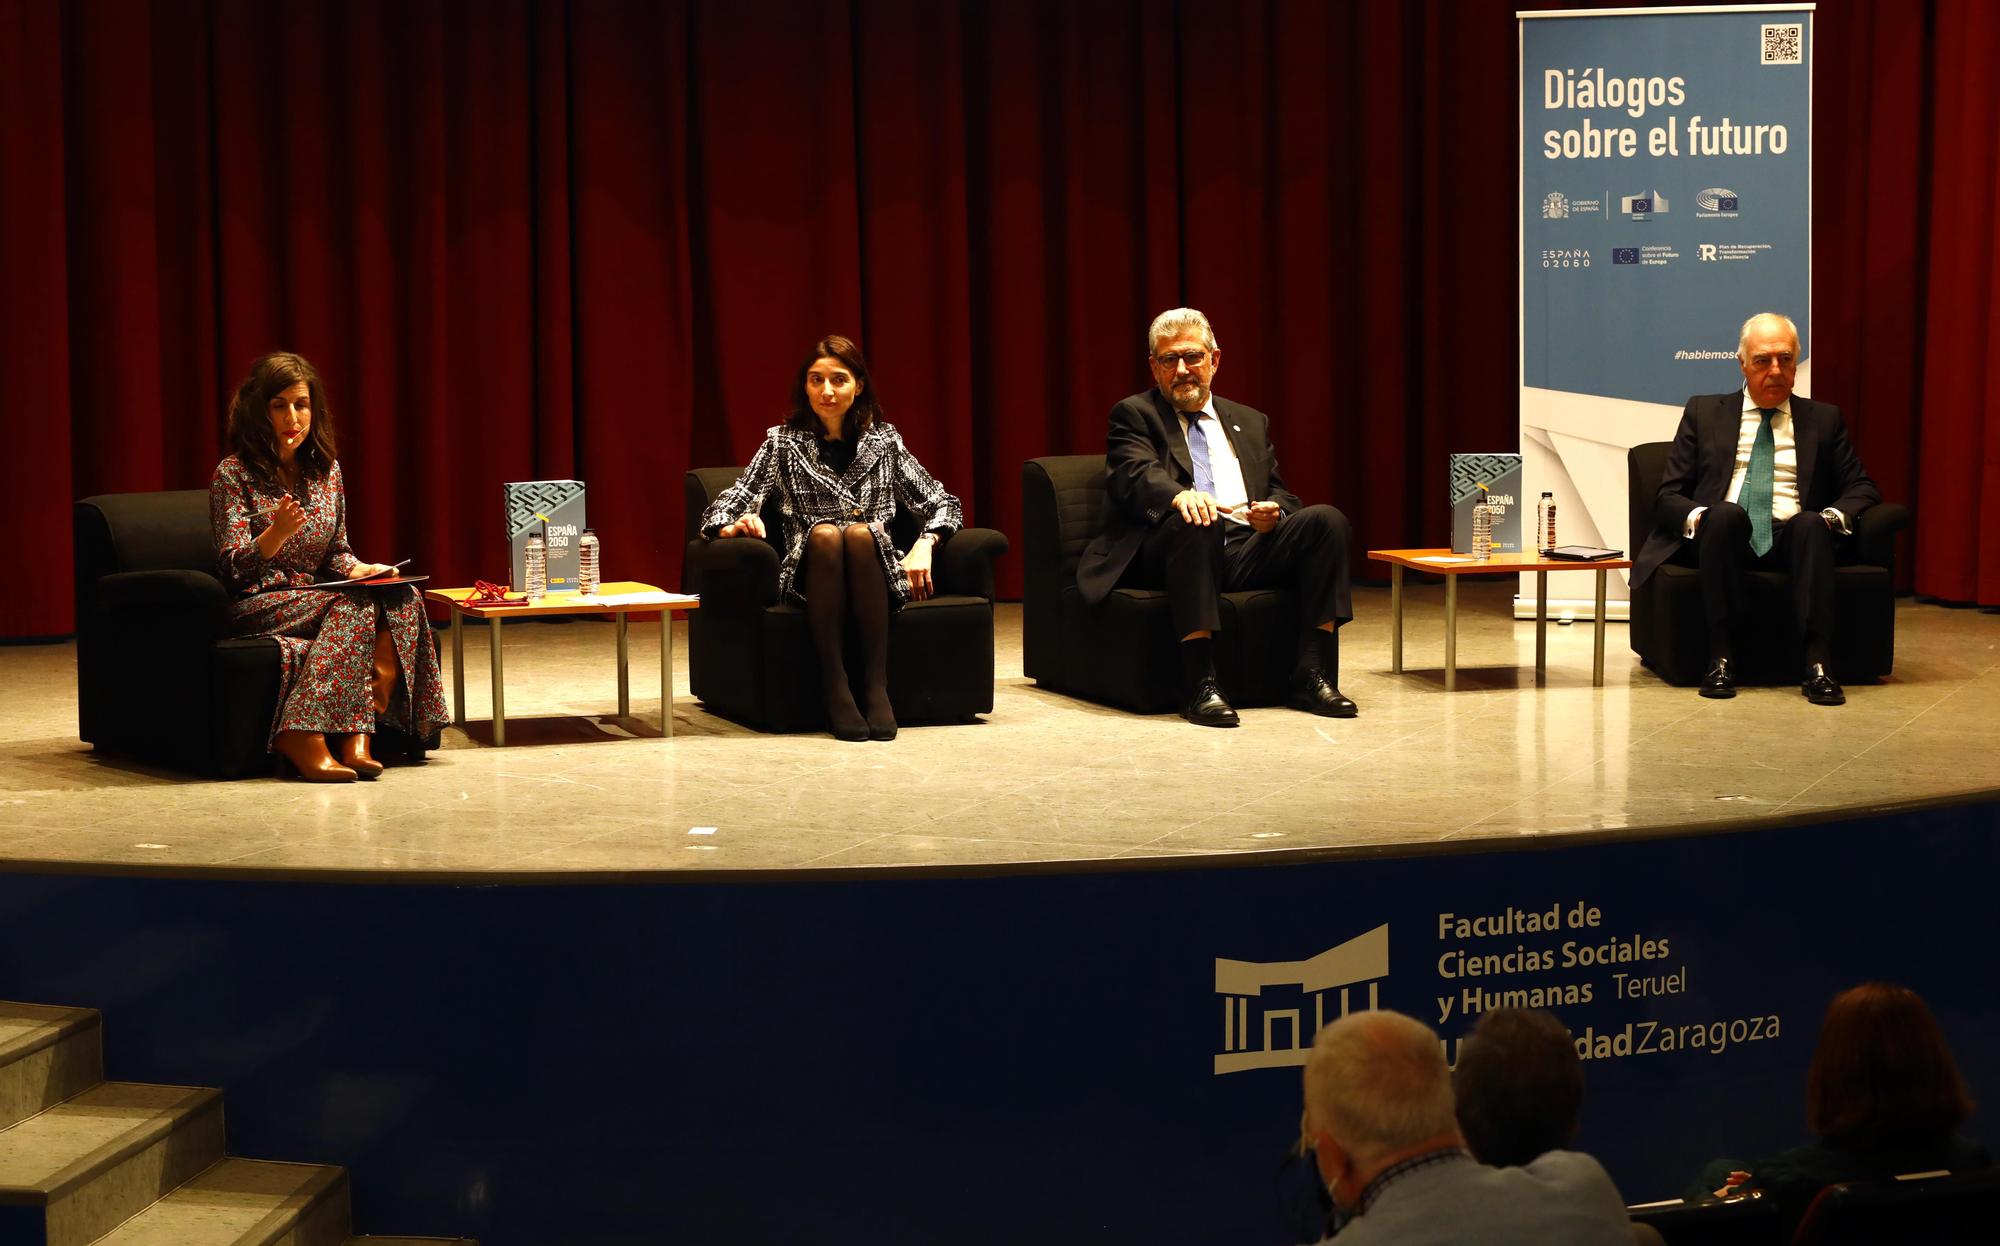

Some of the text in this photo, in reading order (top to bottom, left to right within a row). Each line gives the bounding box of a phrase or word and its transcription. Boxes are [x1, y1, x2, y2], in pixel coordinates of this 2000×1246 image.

[1544, 68, 1685, 118] Diálogos
[1543, 116, 1788, 159] sobre el futuro
[1542, 248, 1590, 259] ESPAÑA
[1487, 494, 1514, 505] ESPAÑA
[548, 523, 578, 536] ESPAÑA
[548, 536, 569, 547] 2050
[1438, 901, 1601, 940] Facultad de
[1437, 934, 1670, 979] Ciencias Sociales
[1437, 966, 1687, 1025] y Humanas Teruel
